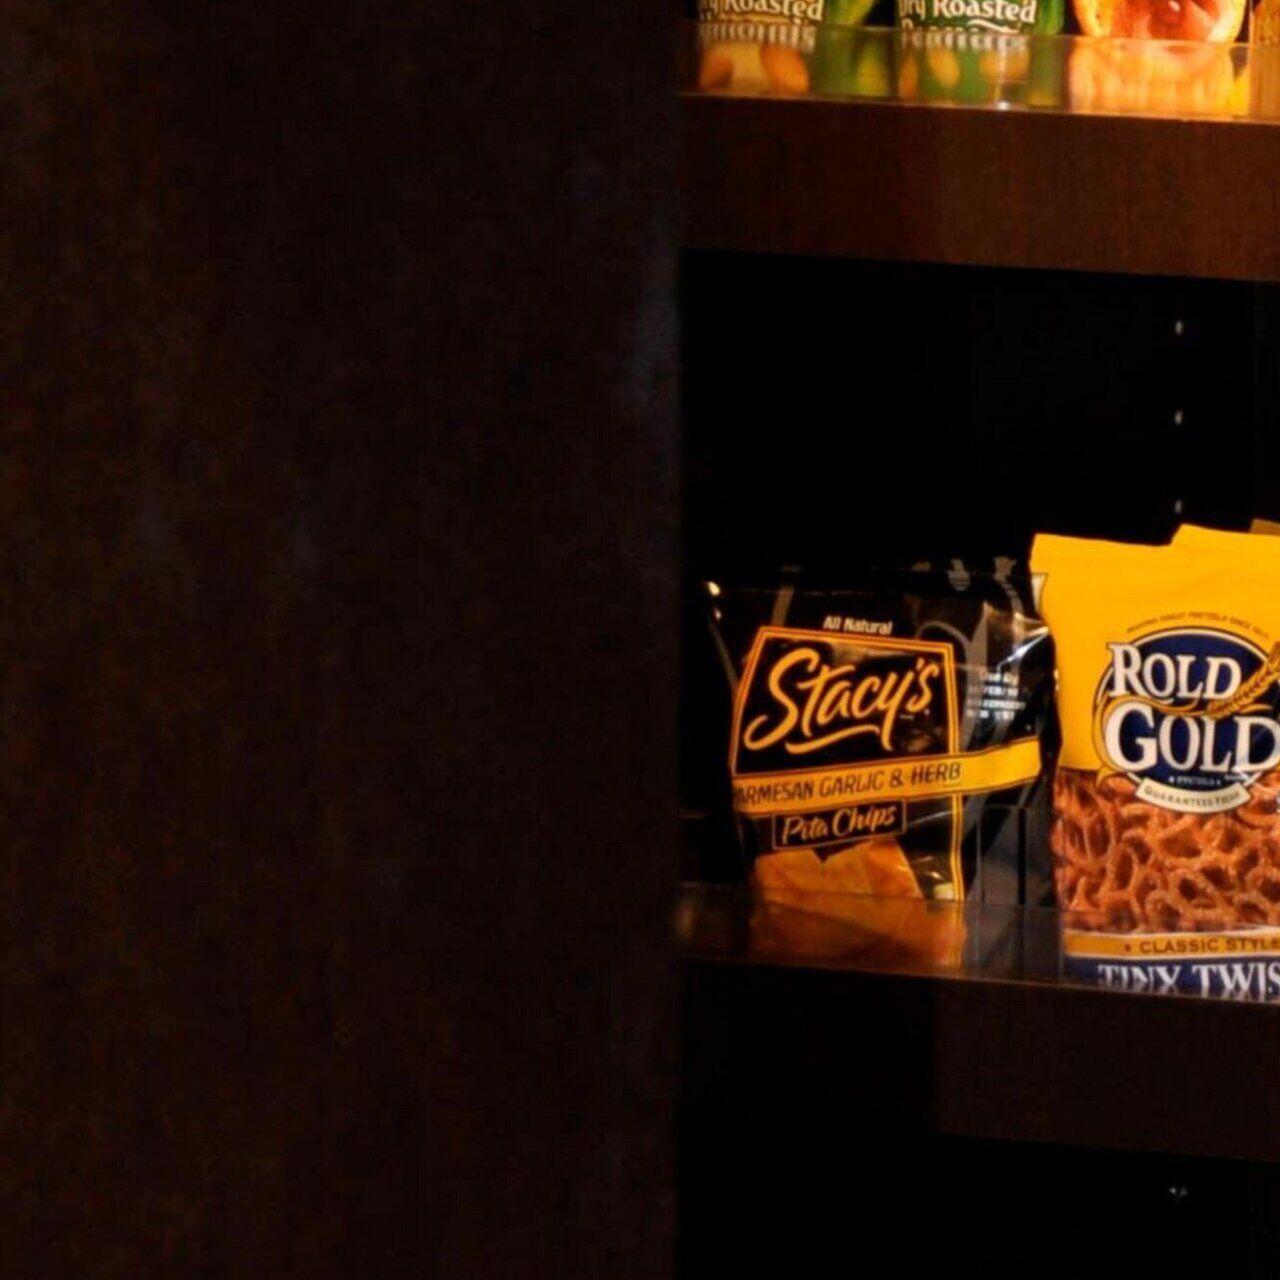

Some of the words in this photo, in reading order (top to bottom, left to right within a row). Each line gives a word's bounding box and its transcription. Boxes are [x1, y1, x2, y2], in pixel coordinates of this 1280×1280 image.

[823, 615, 841, 631] All
[844, 617, 892, 635] Natural
[1107, 642, 1242, 704] ROLD
[744, 646, 940, 753] Stacy's
[819, 770, 885, 794] GARLIC
[889, 770, 904, 787] &
[911, 761, 962, 783] HERB
[781, 817, 830, 844] Pita
[833, 804, 897, 837] Chips
[1139, 937, 1219, 954] CLASSIC
[1098, 962, 1183, 988] TINY
